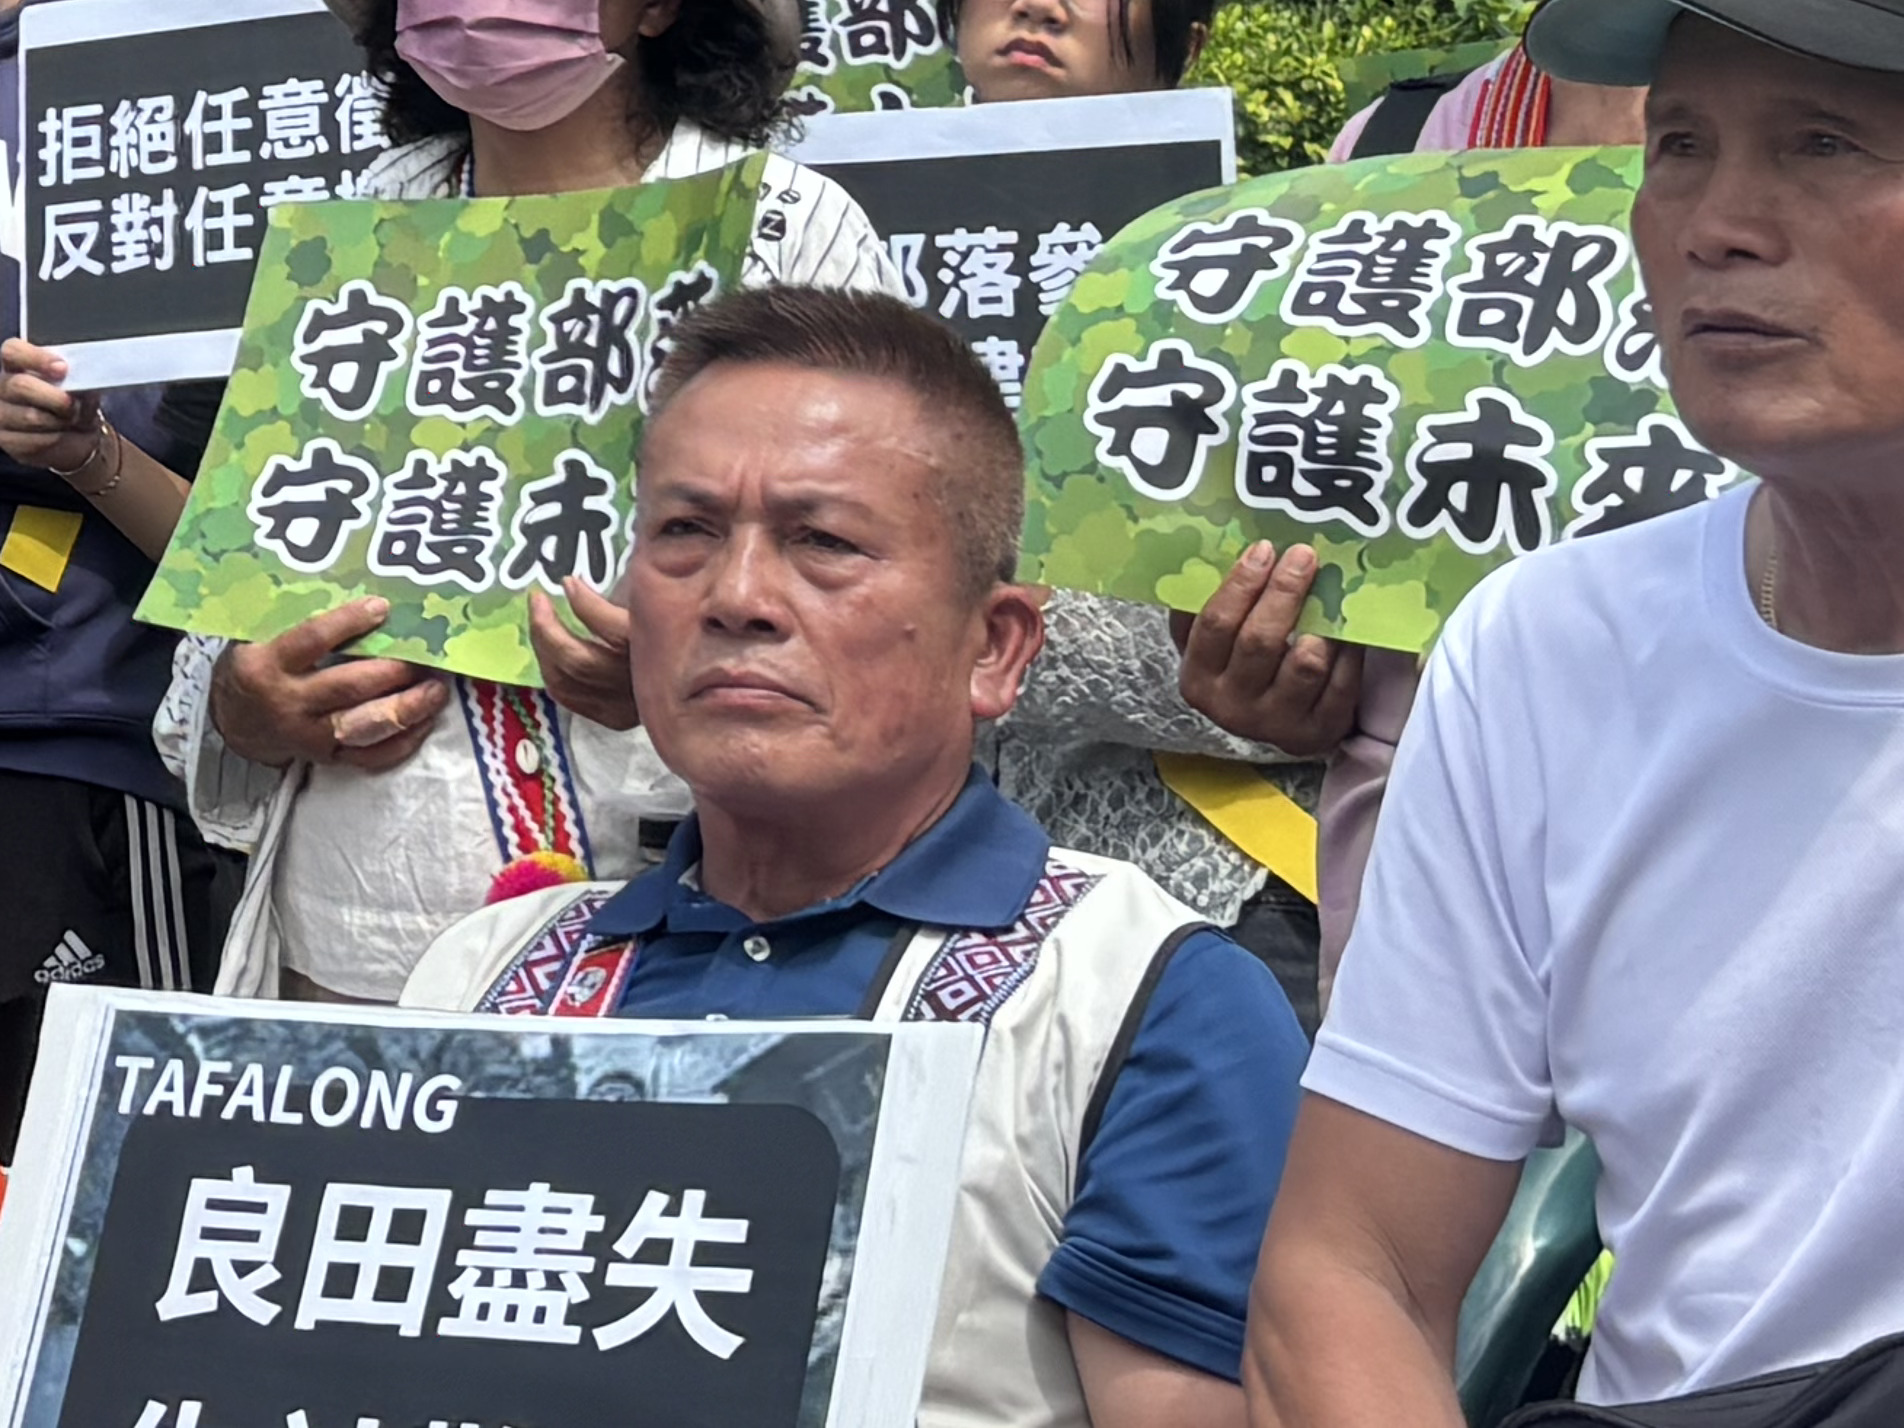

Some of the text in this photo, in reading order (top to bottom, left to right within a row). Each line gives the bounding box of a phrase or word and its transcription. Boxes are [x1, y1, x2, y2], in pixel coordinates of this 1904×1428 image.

[38, 170, 374, 281] 反對任
[115, 1055, 461, 1134] TAFALONG
[155, 1165, 755, 1360] 良田盡失
